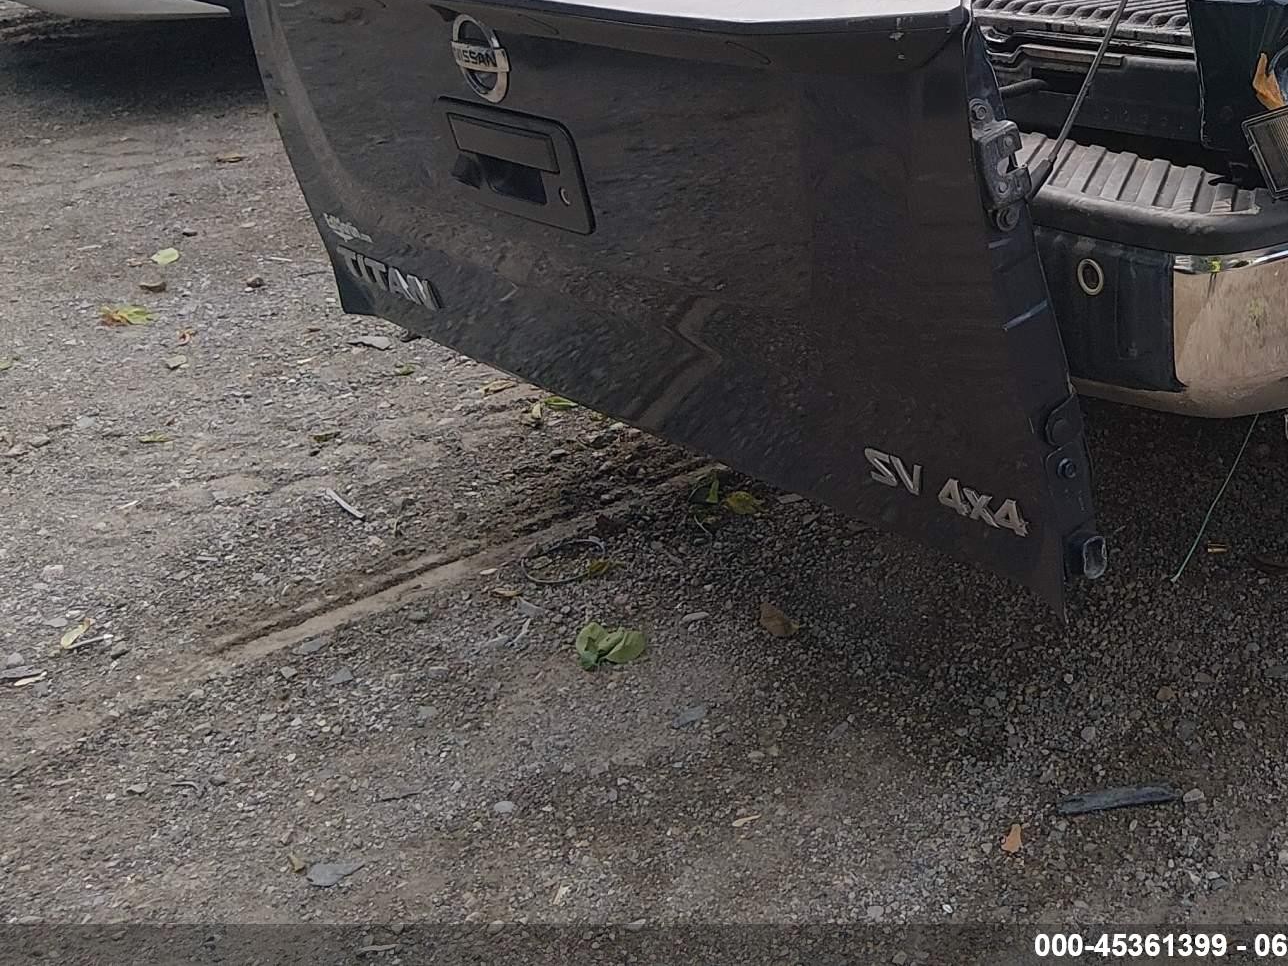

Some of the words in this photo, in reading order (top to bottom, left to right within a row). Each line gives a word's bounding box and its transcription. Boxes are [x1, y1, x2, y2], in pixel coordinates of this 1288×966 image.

[453, 47, 497, 68] NISSAN
[336, 244, 438, 311] TITAN
[864, 447, 922, 496] SV
